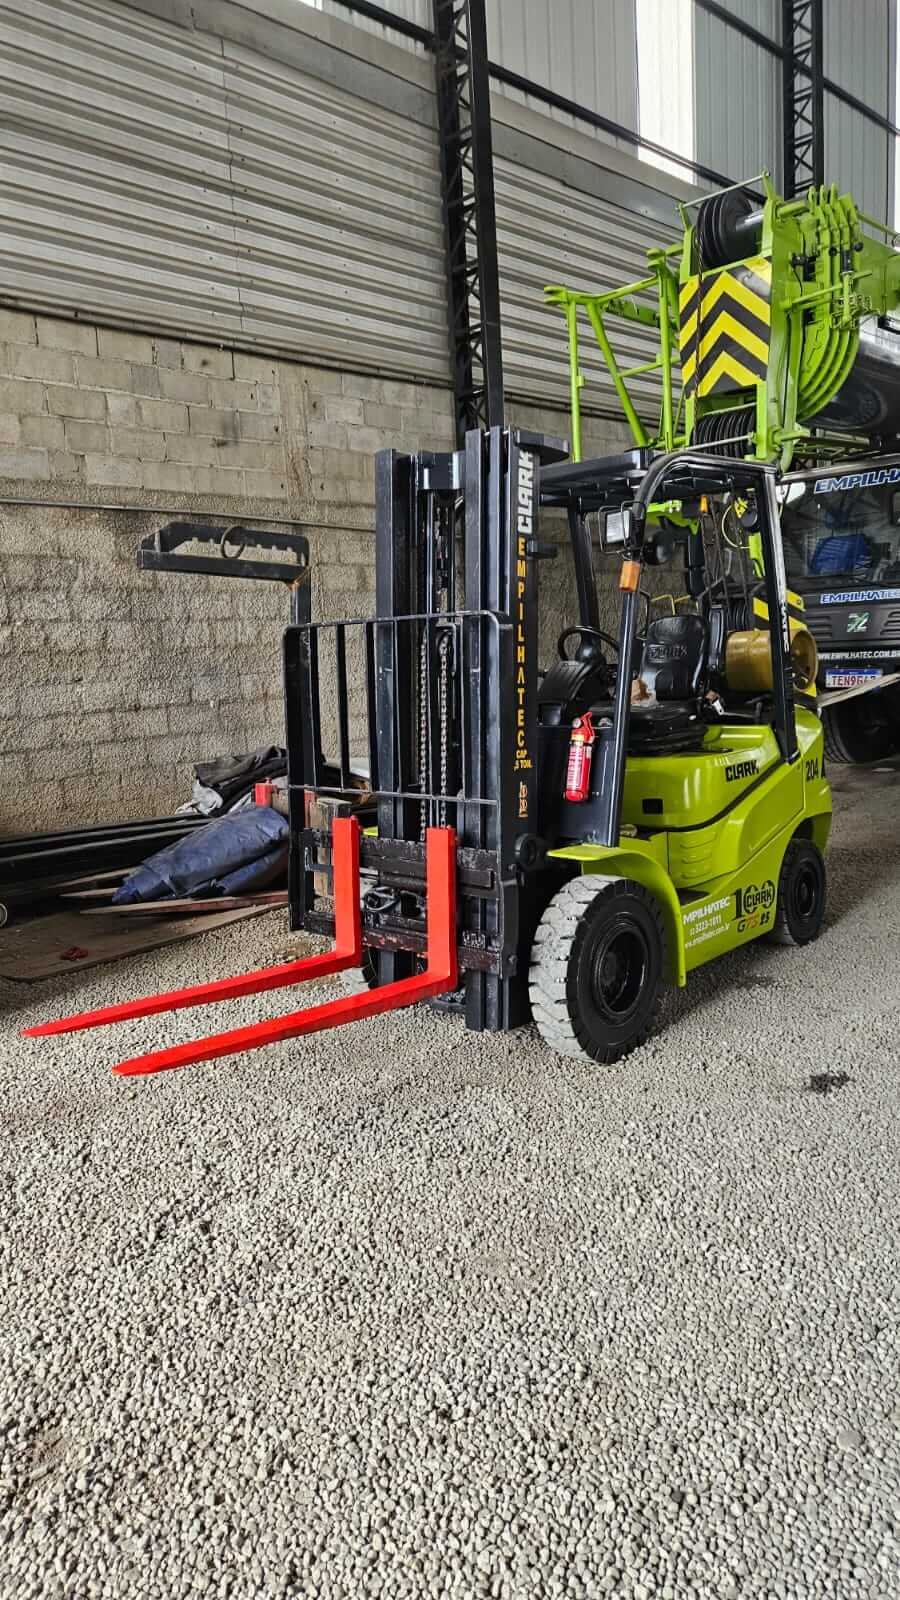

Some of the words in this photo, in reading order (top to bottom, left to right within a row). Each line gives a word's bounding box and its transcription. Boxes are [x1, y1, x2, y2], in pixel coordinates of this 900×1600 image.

[518, 450, 534, 534] CLARK
[516, 537, 527, 747] EMPILHATEC
[516, 750, 528, 758] CAP
[725, 759, 760, 782] CLARK
[805, 758, 819, 782] 204
[746, 888, 772, 908] CLARK
